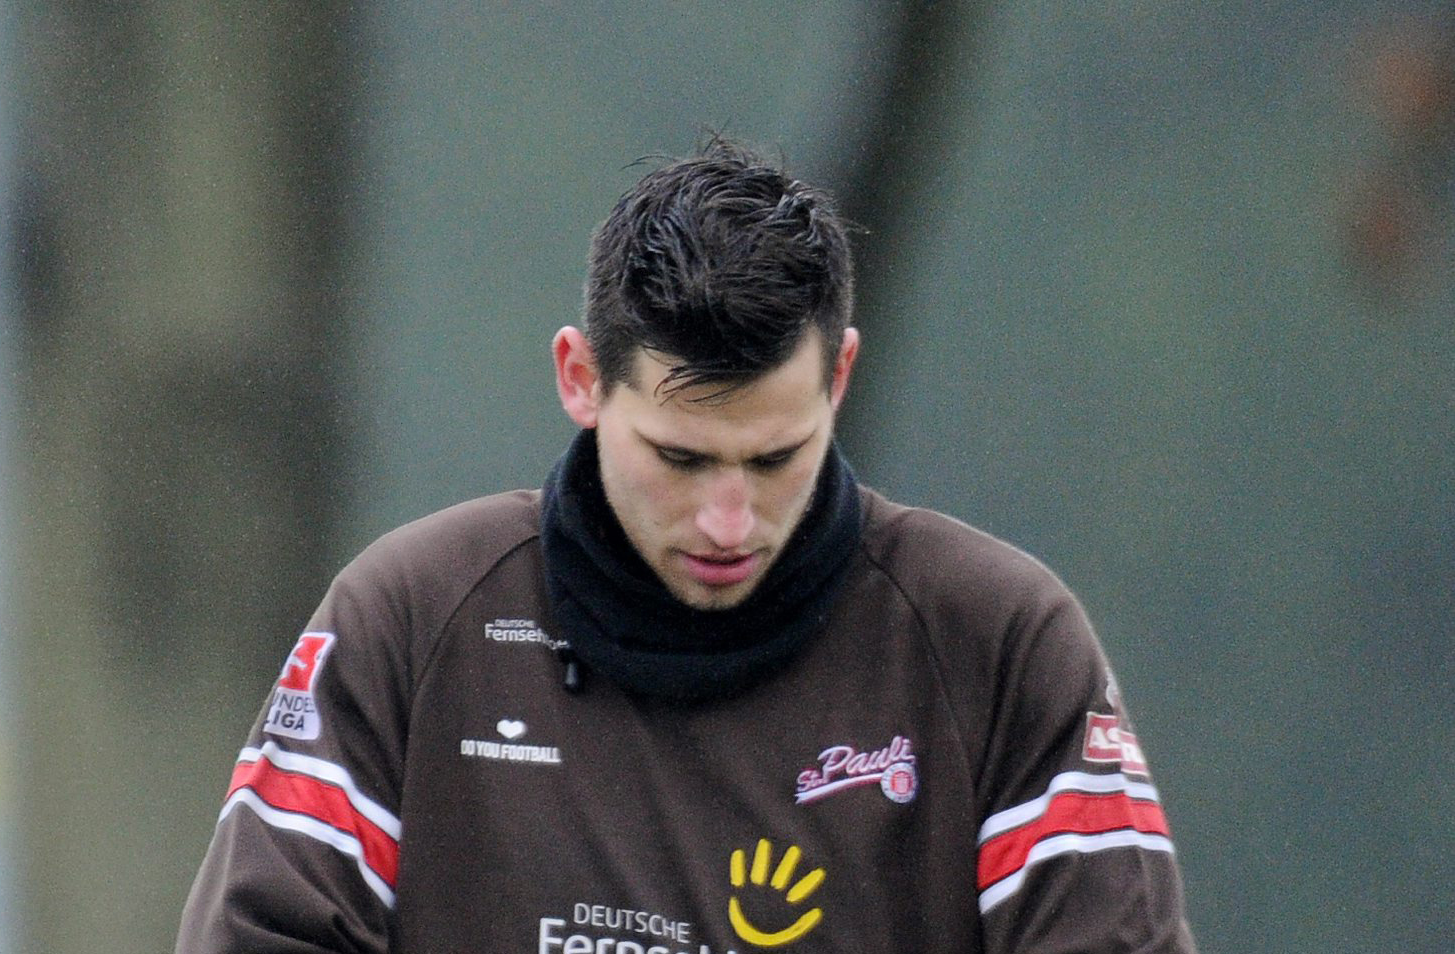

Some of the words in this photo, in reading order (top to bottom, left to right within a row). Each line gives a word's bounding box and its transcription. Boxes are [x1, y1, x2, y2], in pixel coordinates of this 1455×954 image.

[265, 710, 305, 731] IGA
[460, 739, 476, 756] DO
[476, 741, 500, 759] YOU
[500, 745, 562, 763] FOOTBALL
[817, 735, 916, 782] Pauli
[573, 902, 691, 944] DEUTSCHE
